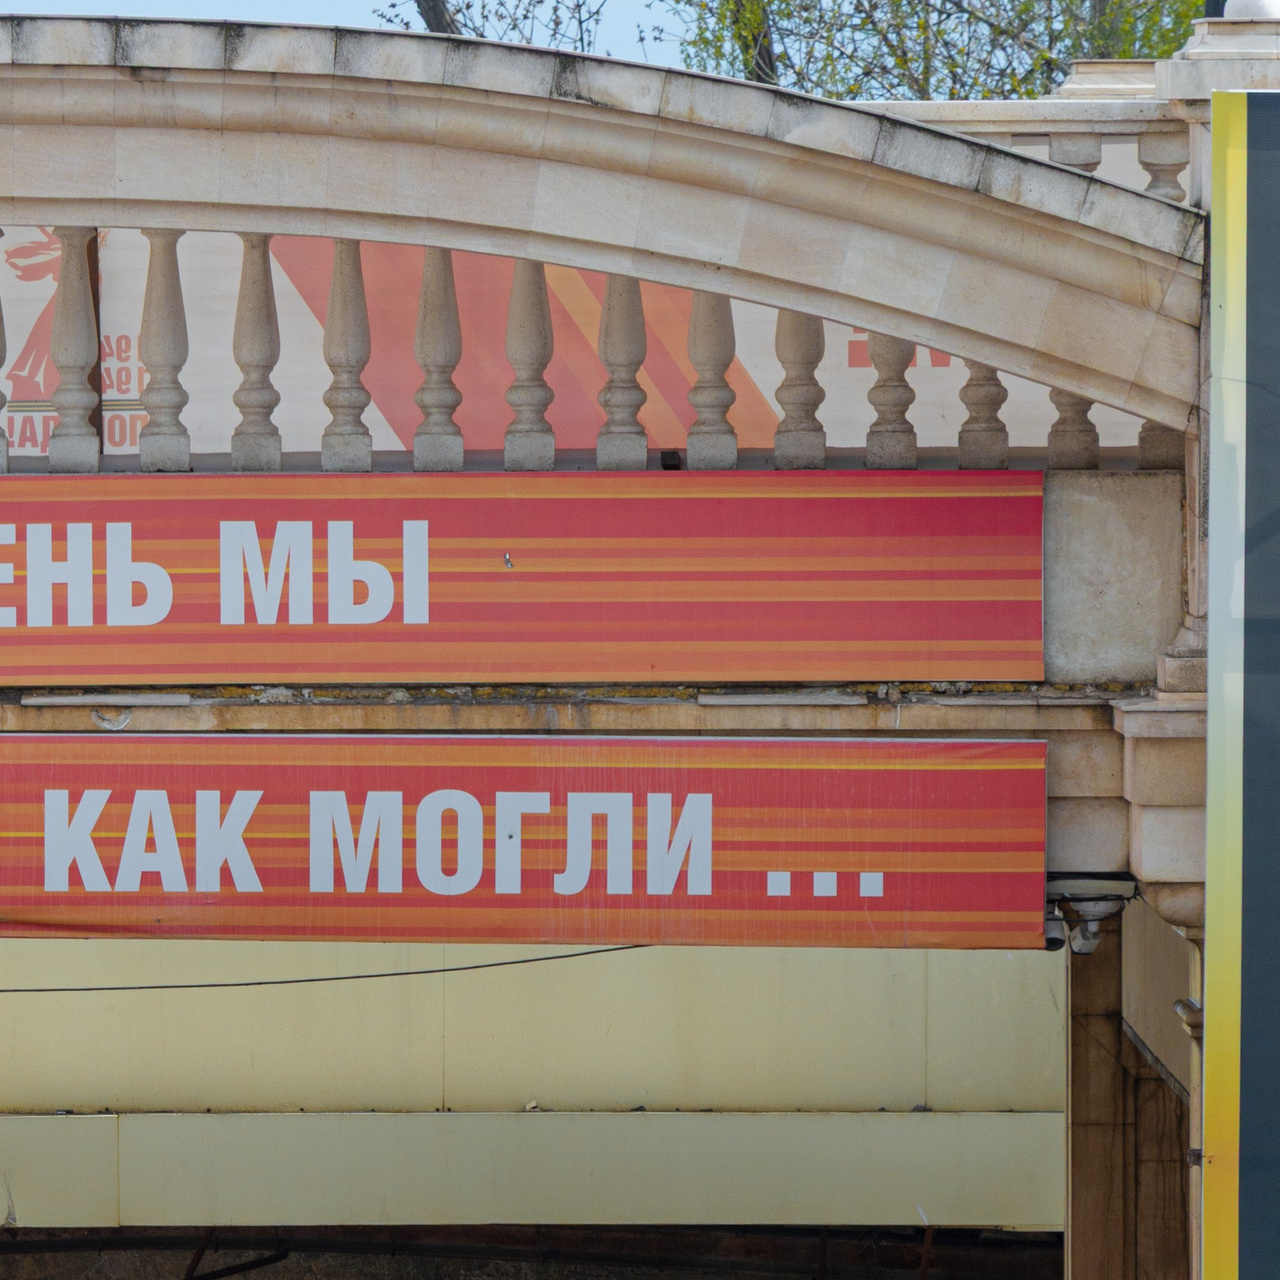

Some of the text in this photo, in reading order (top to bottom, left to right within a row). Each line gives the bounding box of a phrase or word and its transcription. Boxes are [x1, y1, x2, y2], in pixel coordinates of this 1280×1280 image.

[219, 519, 430, 626] МЫ
[44, 788, 264, 894] КАК
[309, 788, 713, 897] МОГЛИ
